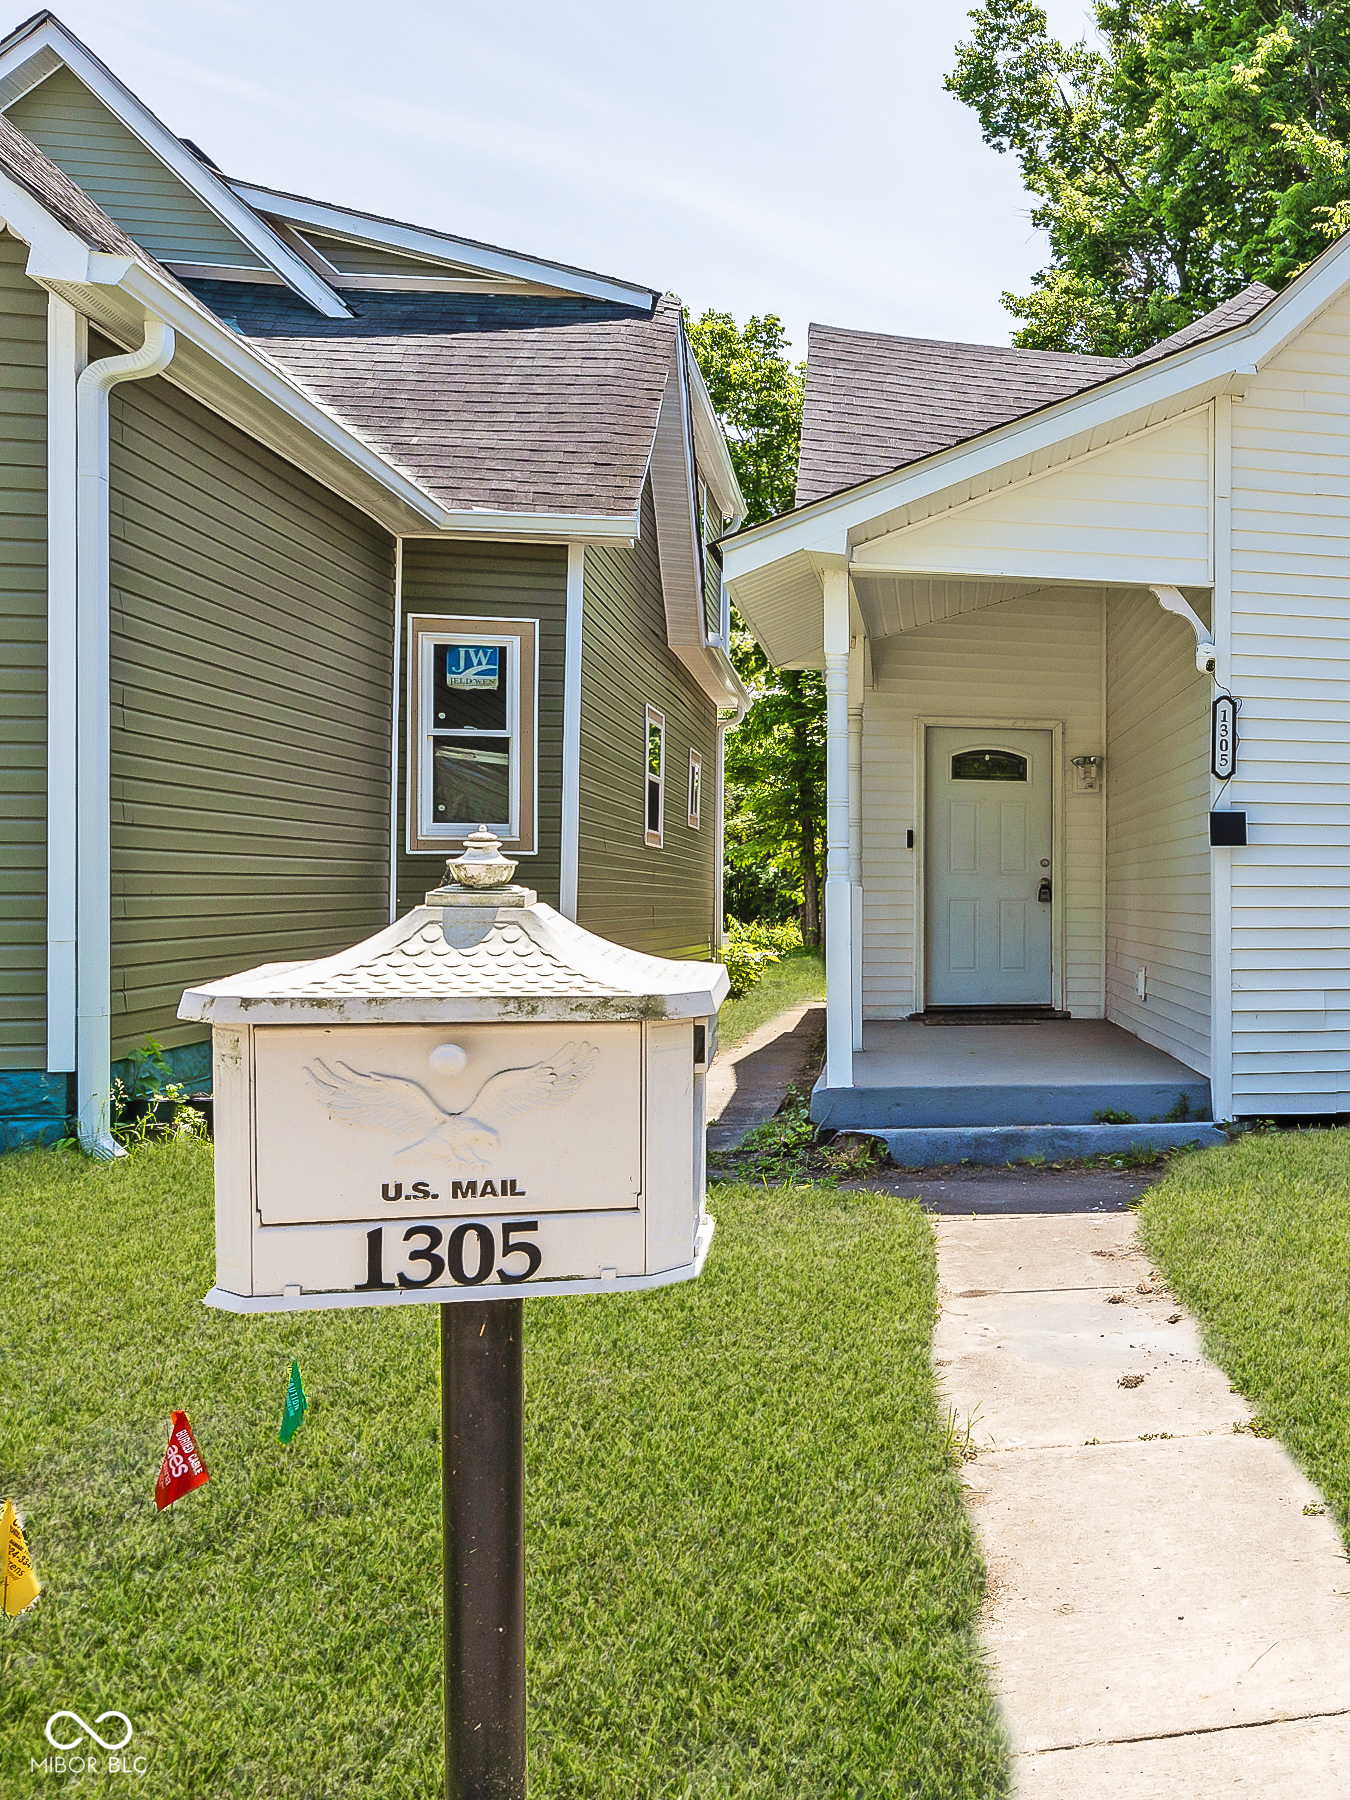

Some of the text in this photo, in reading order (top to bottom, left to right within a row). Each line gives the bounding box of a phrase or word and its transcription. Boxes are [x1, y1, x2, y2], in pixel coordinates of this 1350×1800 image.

[451, 648, 494, 672] JW
[1218, 709, 1229, 767] 1305
[381, 1177, 527, 1202] U.S. MAIL
[354, 1220, 542, 1290] 1305
[167, 1444, 189, 1478] aes
[175, 1428, 203, 1476] BURIED CABLE
